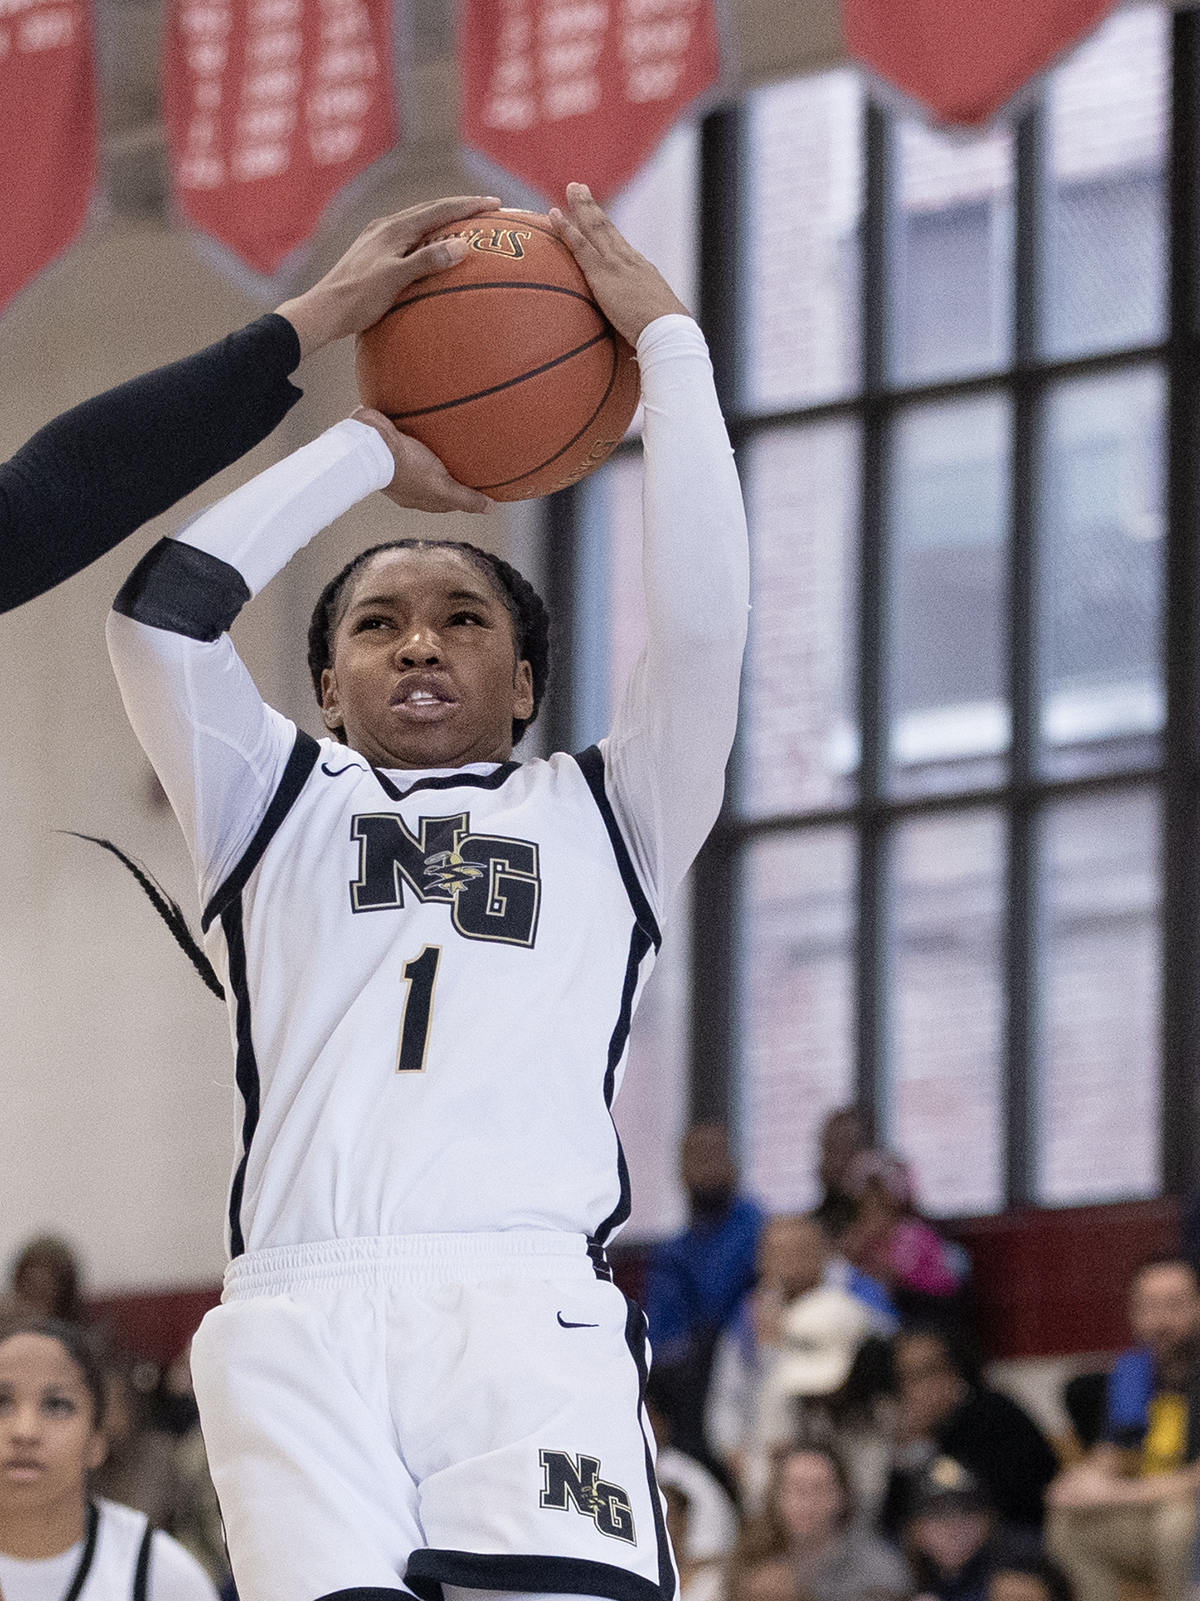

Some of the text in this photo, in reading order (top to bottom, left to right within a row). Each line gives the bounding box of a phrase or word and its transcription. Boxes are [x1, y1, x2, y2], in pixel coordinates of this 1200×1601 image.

[350, 811, 542, 949] NG
[395, 943, 443, 1074] 1
[539, 1449, 637, 1547] NG
